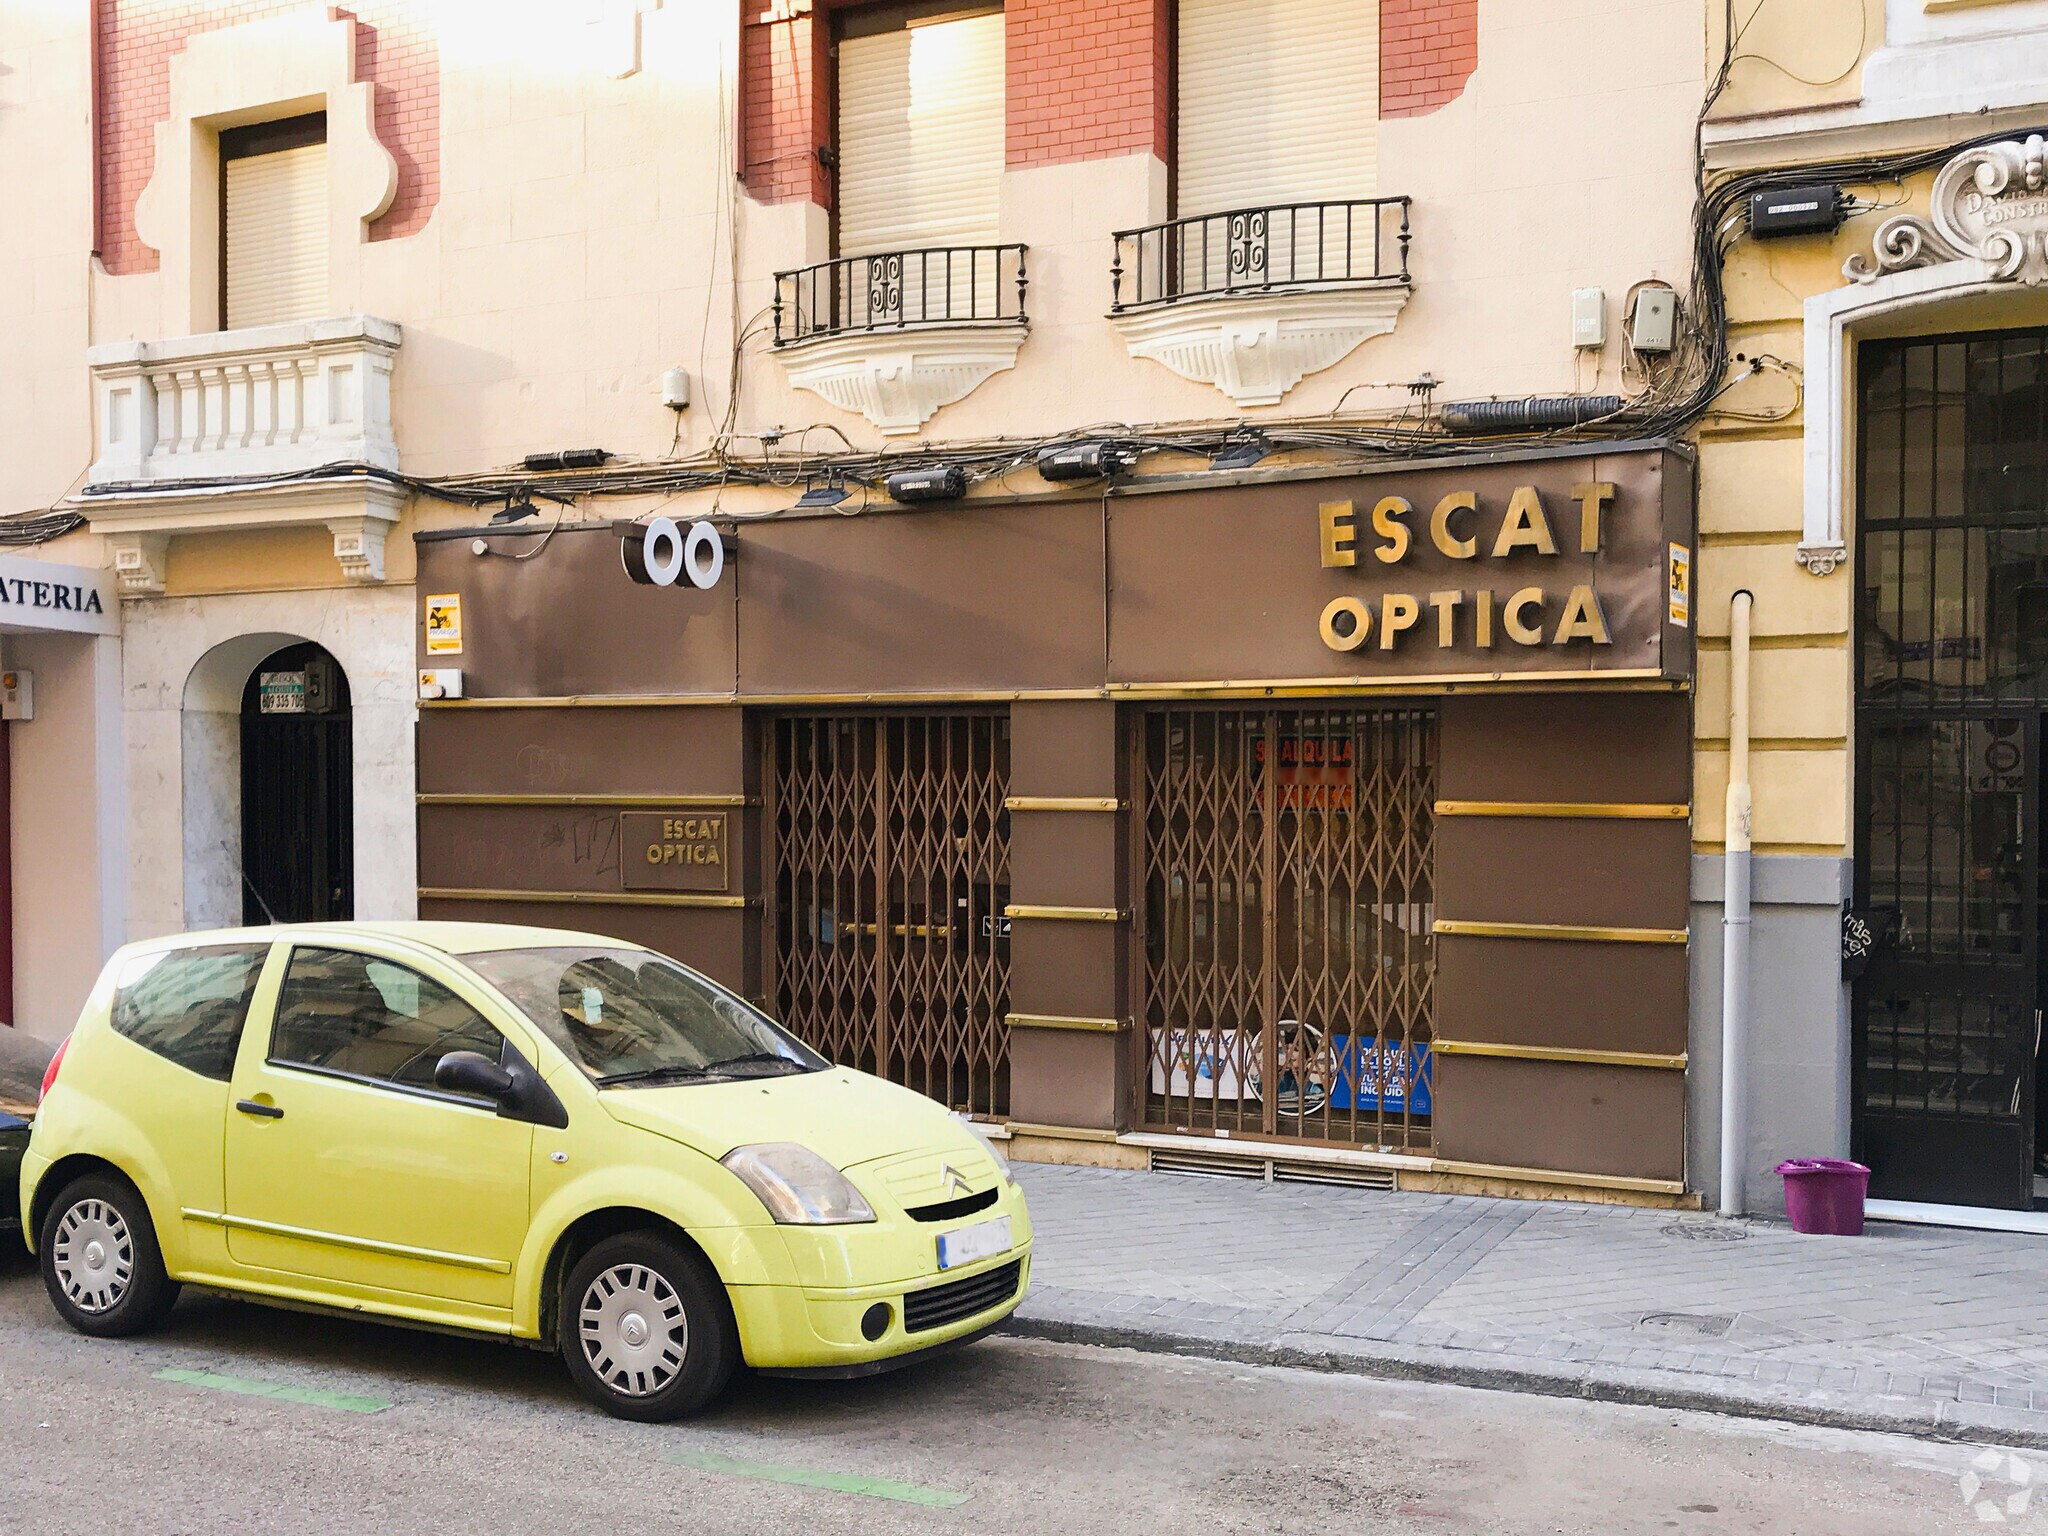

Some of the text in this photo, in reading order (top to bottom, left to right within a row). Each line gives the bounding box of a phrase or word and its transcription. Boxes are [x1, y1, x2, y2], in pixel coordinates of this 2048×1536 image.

[1318, 482, 1615, 568] ESCAT
[1318, 584, 1613, 652] OPTICA
[1280, 739, 1353, 762] ALQULA
[662, 819, 721, 840] ESCAT
[646, 843, 721, 865] OPTICA
